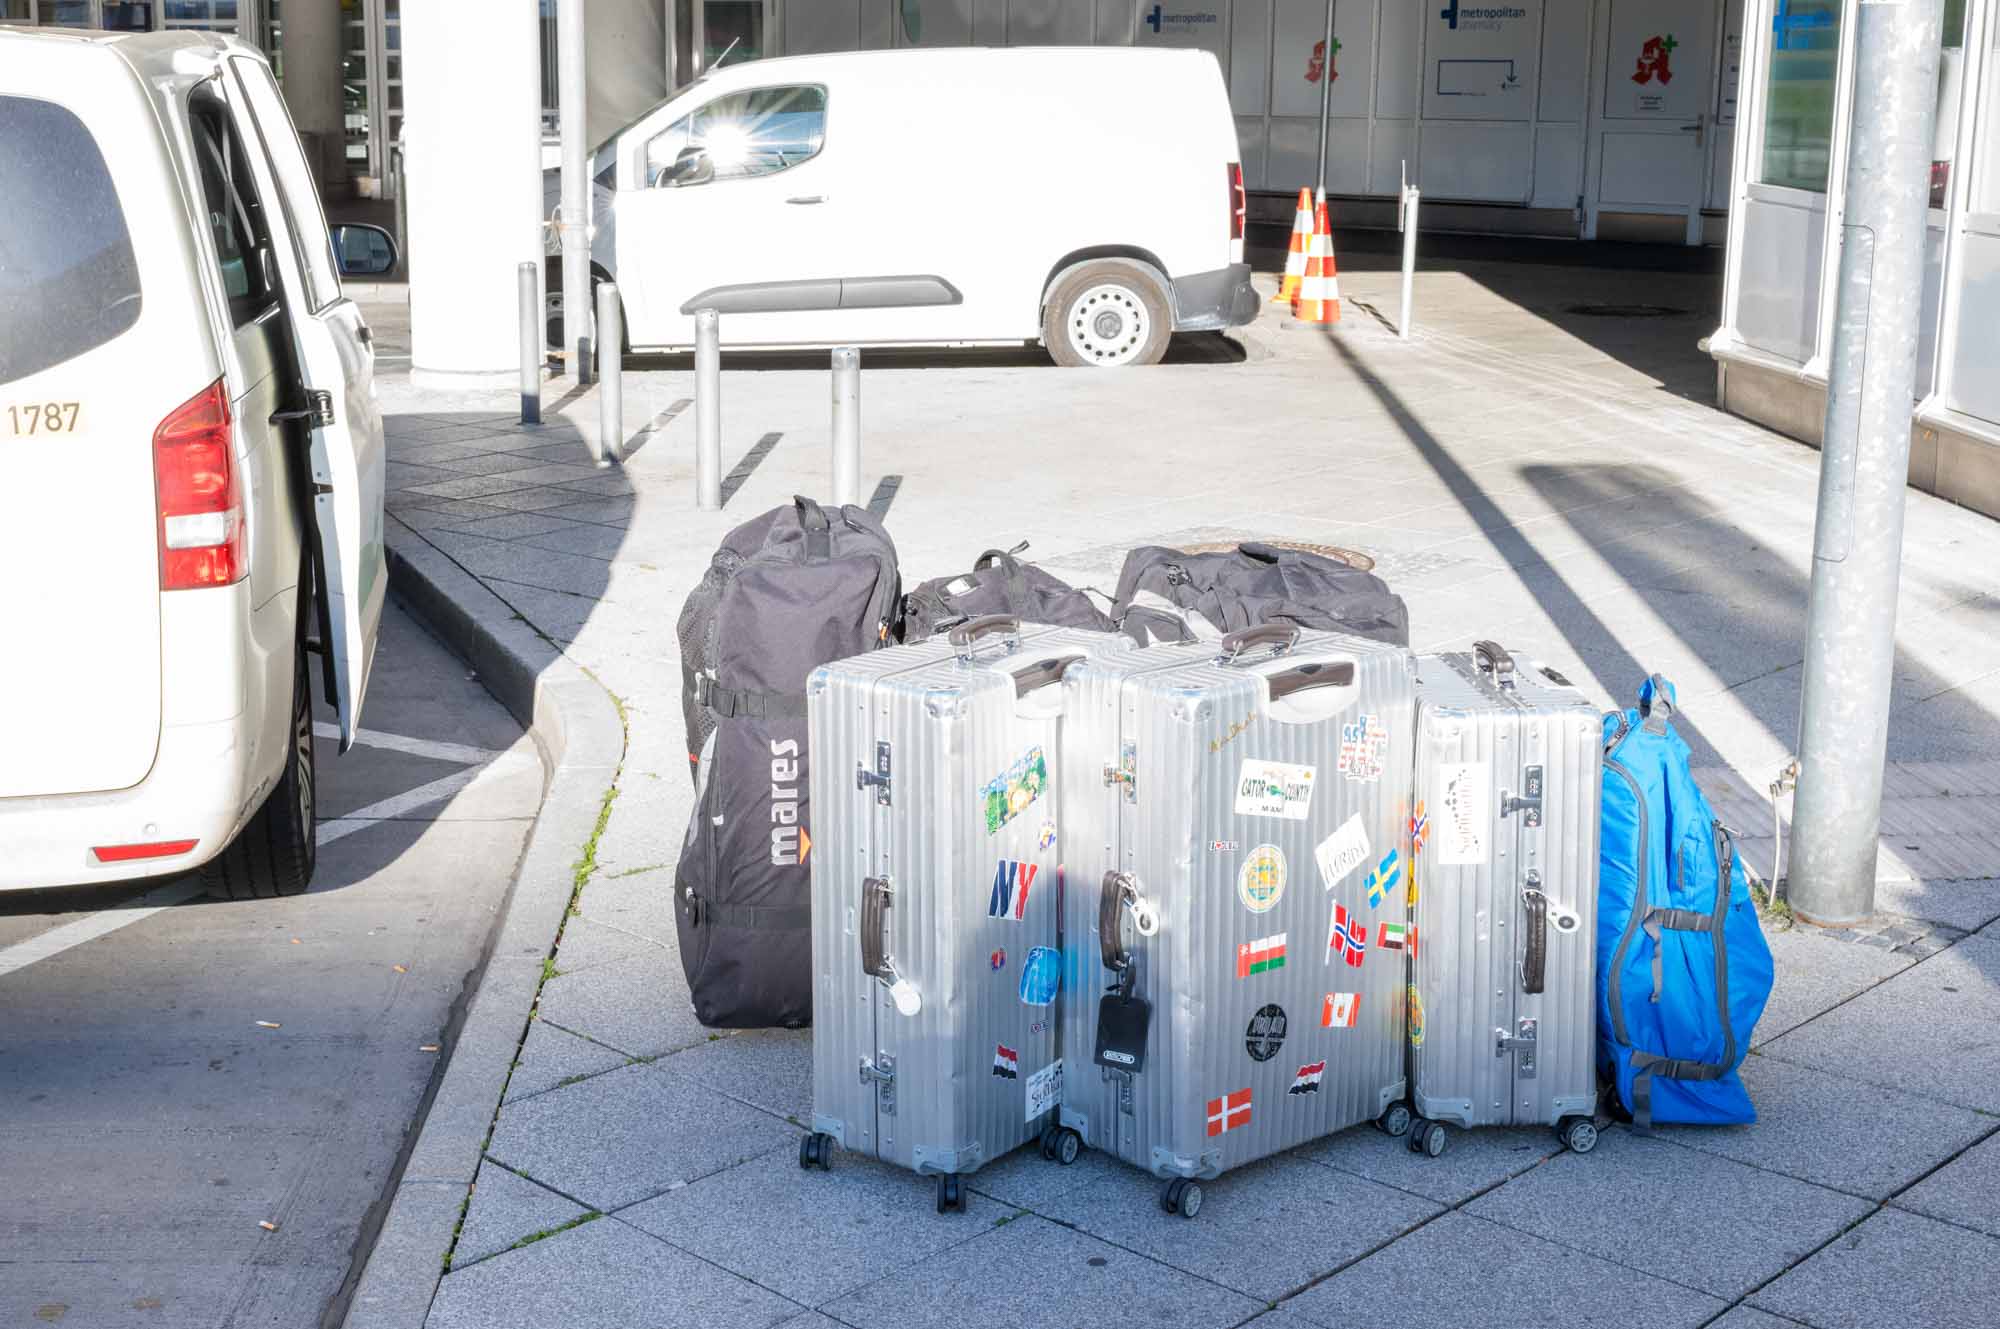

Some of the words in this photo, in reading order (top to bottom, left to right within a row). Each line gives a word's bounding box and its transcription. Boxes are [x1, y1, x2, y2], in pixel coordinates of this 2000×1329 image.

[1460, 6, 1526, 19] metropolitan
[8, 402, 80, 435] 1787
[771, 738, 798, 866] mares
[988, 859, 1038, 920] NY
